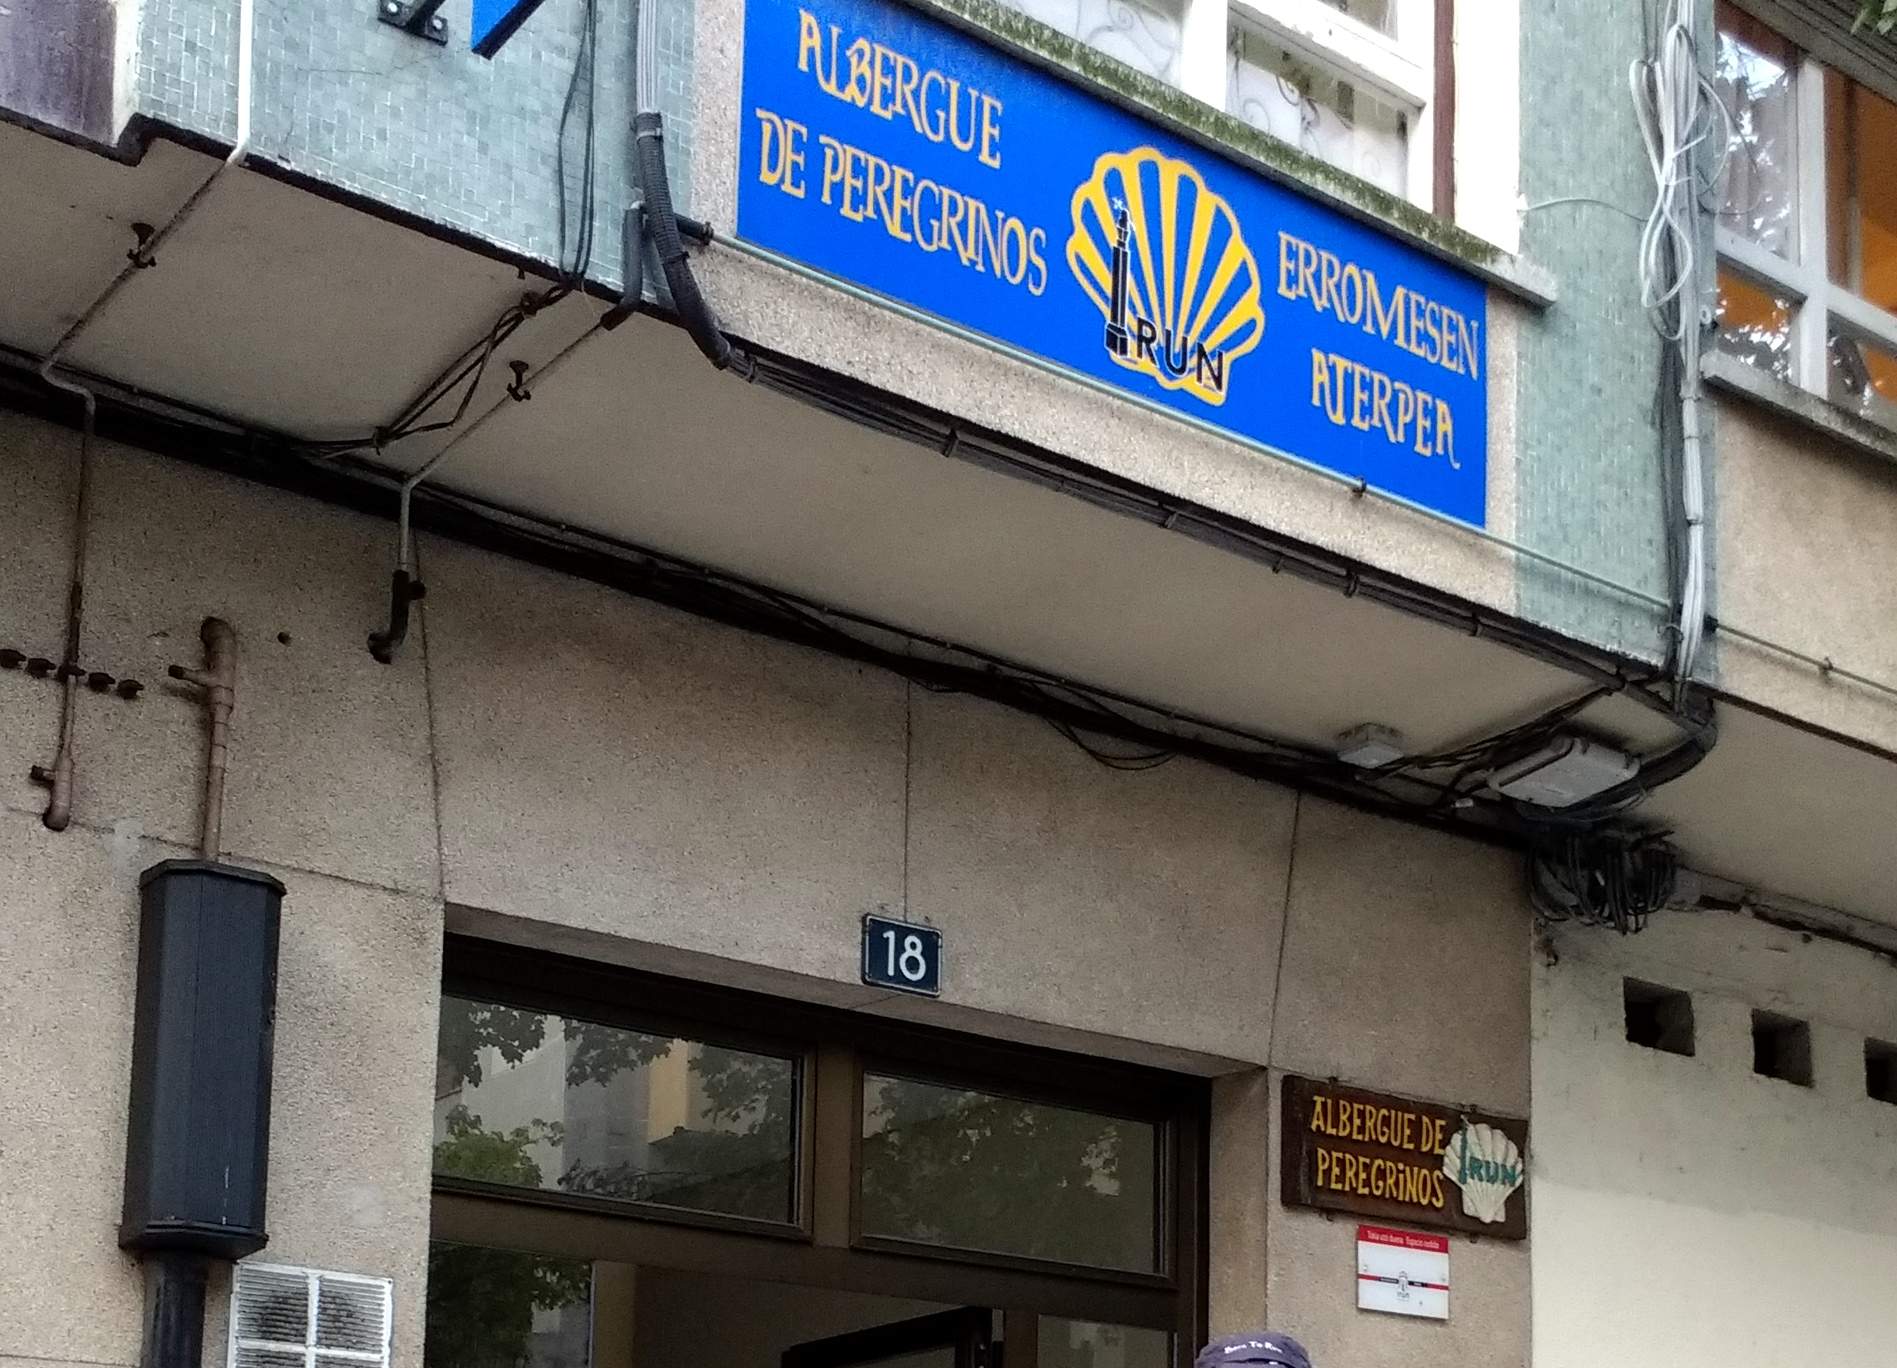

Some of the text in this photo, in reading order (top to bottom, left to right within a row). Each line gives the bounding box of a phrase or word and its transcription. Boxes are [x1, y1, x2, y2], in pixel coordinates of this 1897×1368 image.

[798, 9, 1003, 170] ALBERGUE
[756, 107, 1047, 296] DE PEREGRINOS
[1277, 230, 1479, 381] ERROMESEN
[1311, 347, 1461, 469] ATERPEA
[883, 930, 926, 981] 18
[1310, 1095, 1447, 1155] ALBERGUE DE
